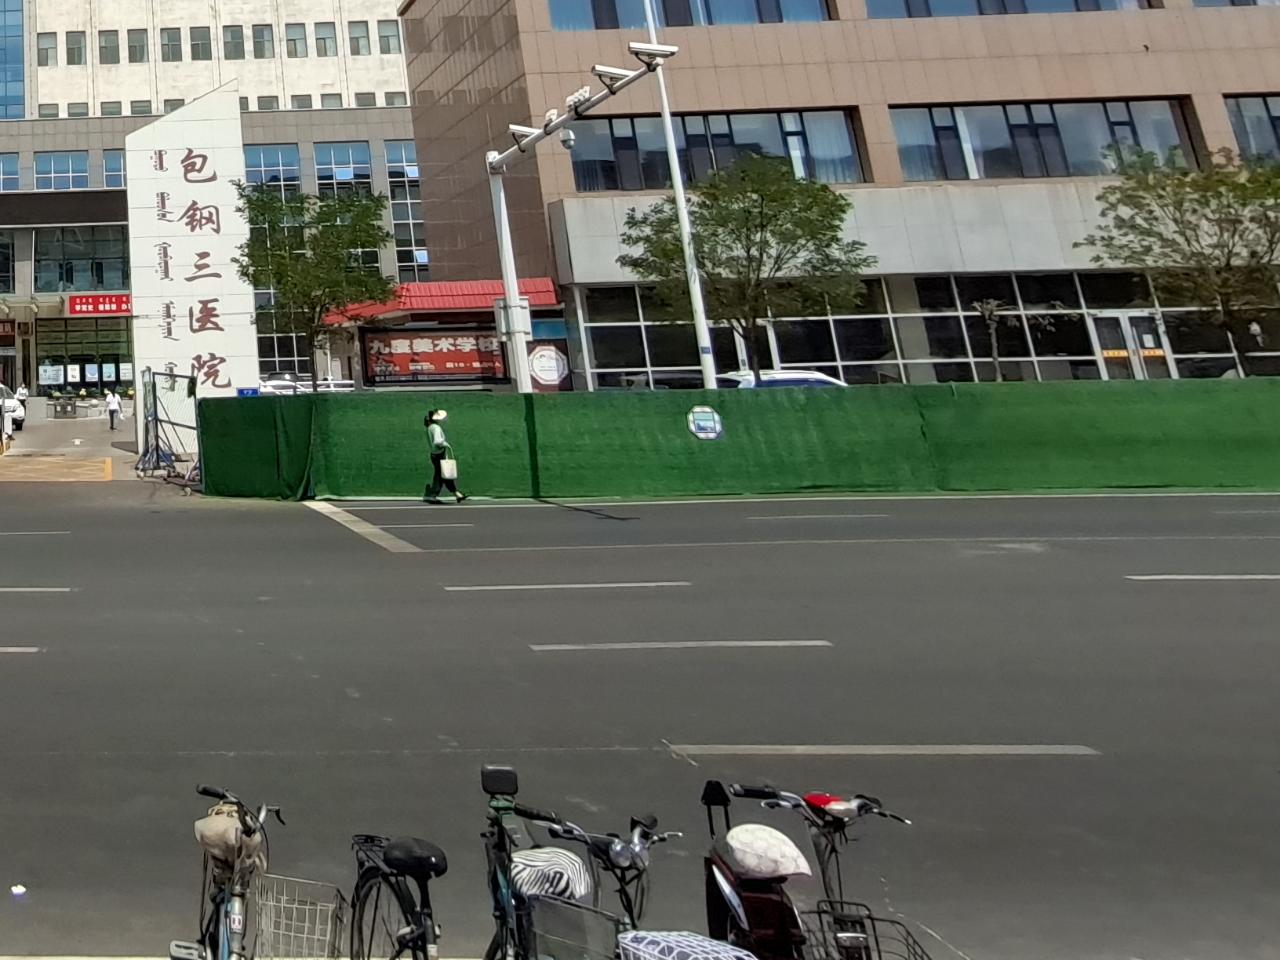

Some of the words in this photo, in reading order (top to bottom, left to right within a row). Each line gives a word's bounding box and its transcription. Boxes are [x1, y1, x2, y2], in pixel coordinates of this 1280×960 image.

[177, 148, 232, 389] 包钢三医院
